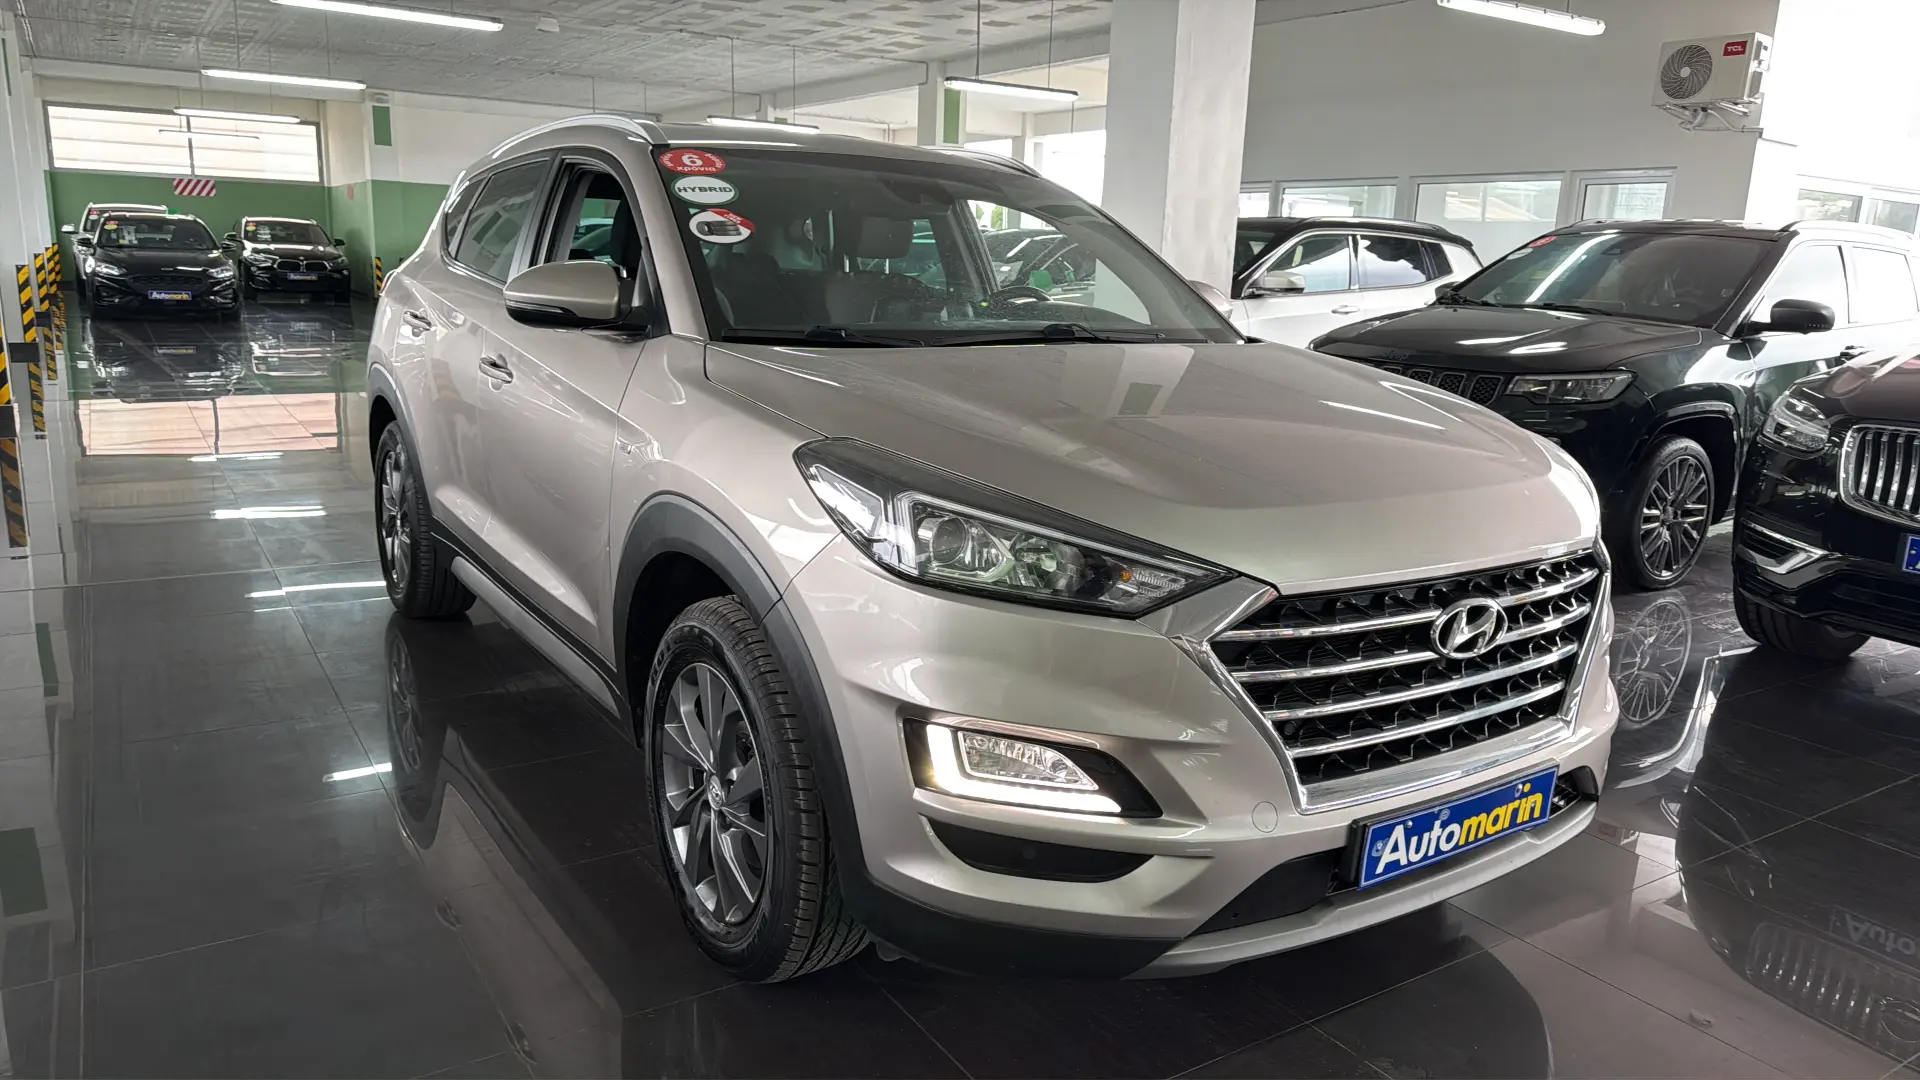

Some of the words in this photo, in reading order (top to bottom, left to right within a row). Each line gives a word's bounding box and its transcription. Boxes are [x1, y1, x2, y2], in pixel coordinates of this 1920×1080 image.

[682, 154, 703, 166] 6
[677, 186, 733, 194] HYBRID
[1375, 783, 1543, 874] Automarin
